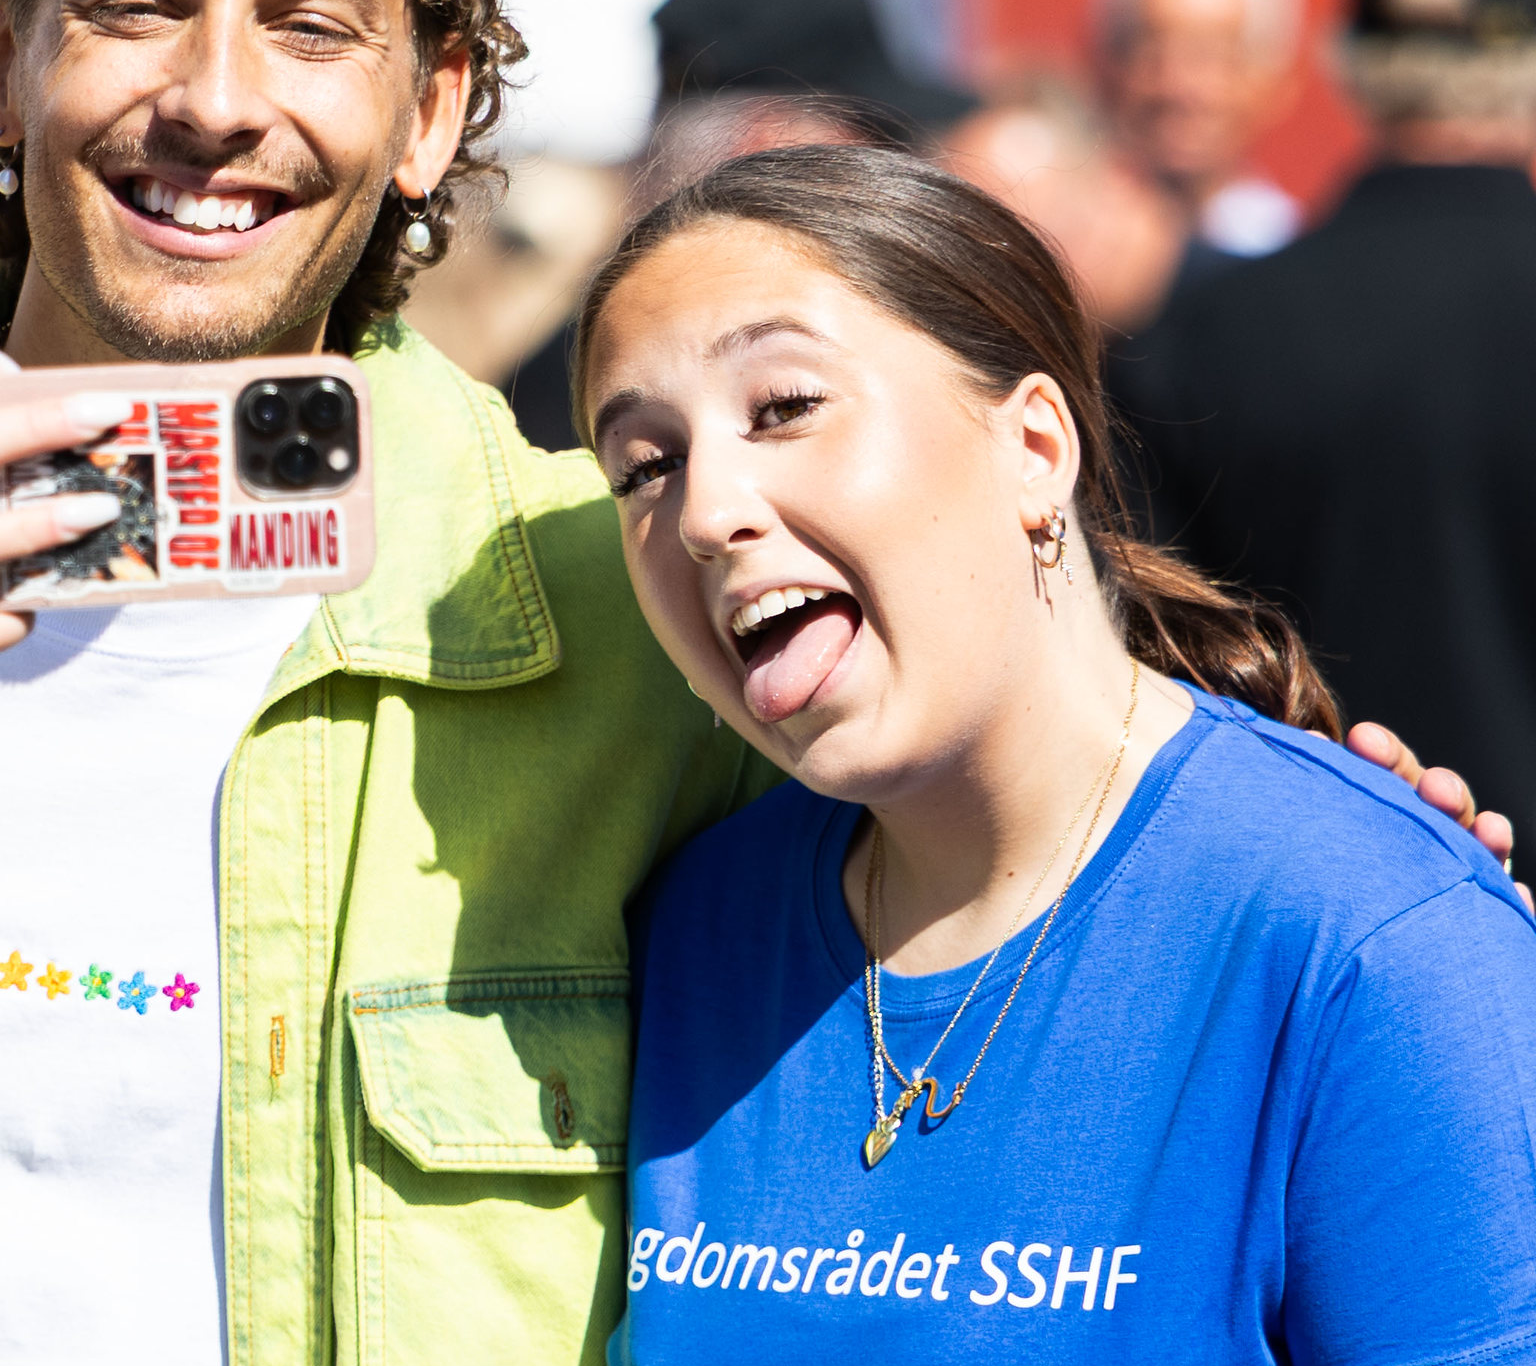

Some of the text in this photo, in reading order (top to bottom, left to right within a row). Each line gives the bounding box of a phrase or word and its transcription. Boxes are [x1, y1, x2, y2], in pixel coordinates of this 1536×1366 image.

[229, 509, 339, 571] MANDING
[626, 1221, 1142, 1312] gdomsrådet SSHF
